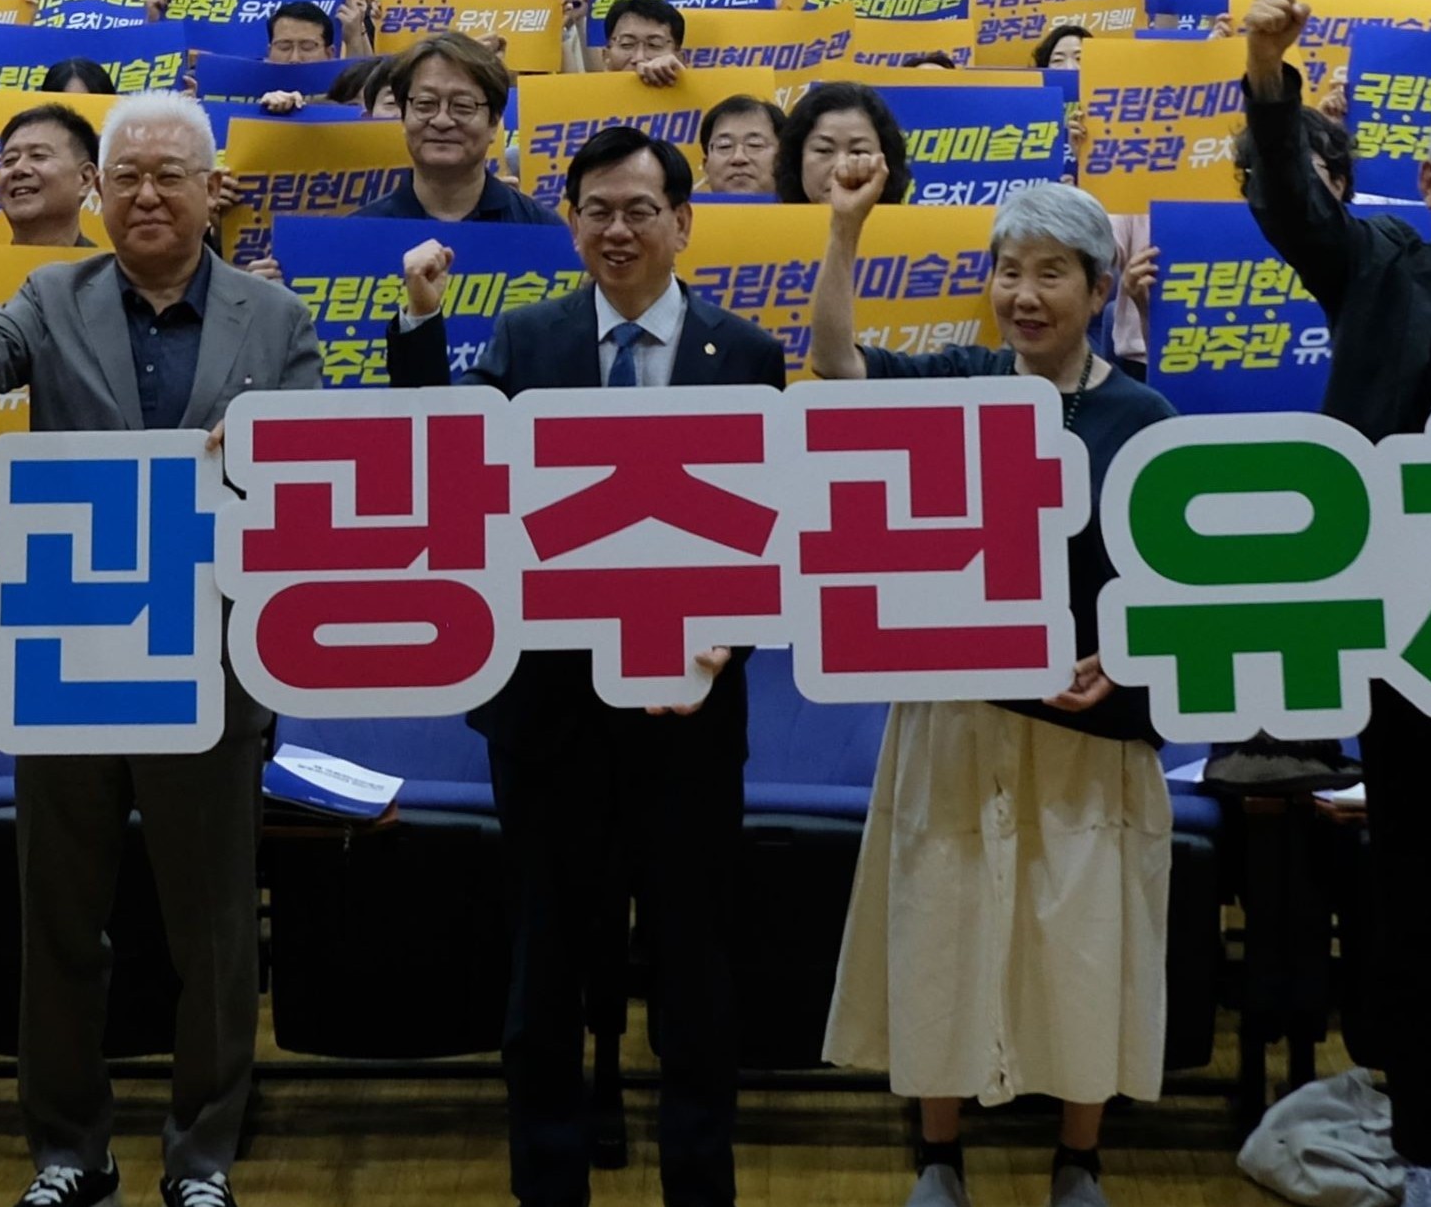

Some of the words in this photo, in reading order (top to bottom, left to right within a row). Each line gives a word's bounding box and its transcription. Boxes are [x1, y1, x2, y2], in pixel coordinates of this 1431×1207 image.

[380, 6, 454, 33] 광주관
[456, 11, 495, 32] 유치
[498, 9, 550, 32] 기원!!
[977, 14, 1046, 46] 광주관
[1088, 7, 1136, 31] 기원!!
[1085, 137, 1185, 176] 광주관
[1159, 321, 1292, 373] 광주관
[244, 405, 1062, 690] 광주관
